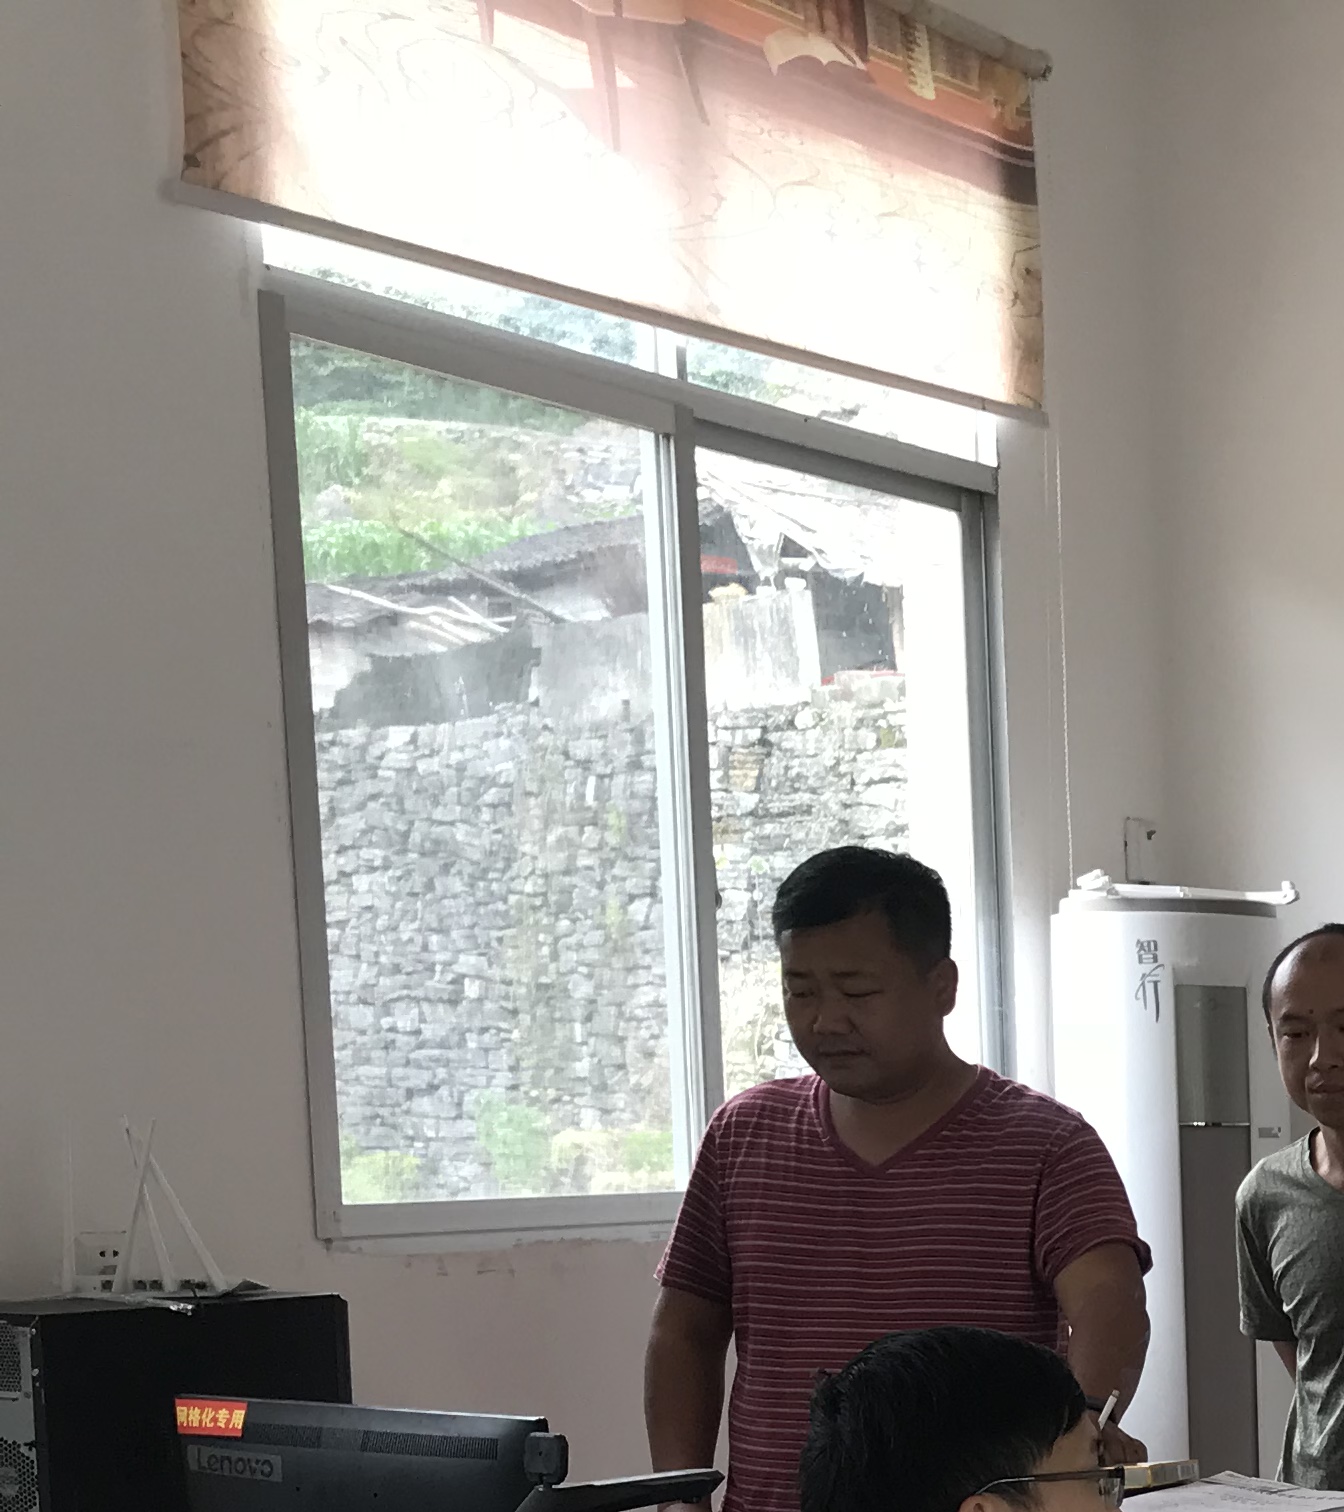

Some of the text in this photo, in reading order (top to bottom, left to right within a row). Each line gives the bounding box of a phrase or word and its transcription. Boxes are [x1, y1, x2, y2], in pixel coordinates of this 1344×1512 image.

[1135, 938, 1165, 1024] 智行
[176, 1406, 246, 1430] 网格化专用
[197, 1447, 274, 1478] Lenovo
